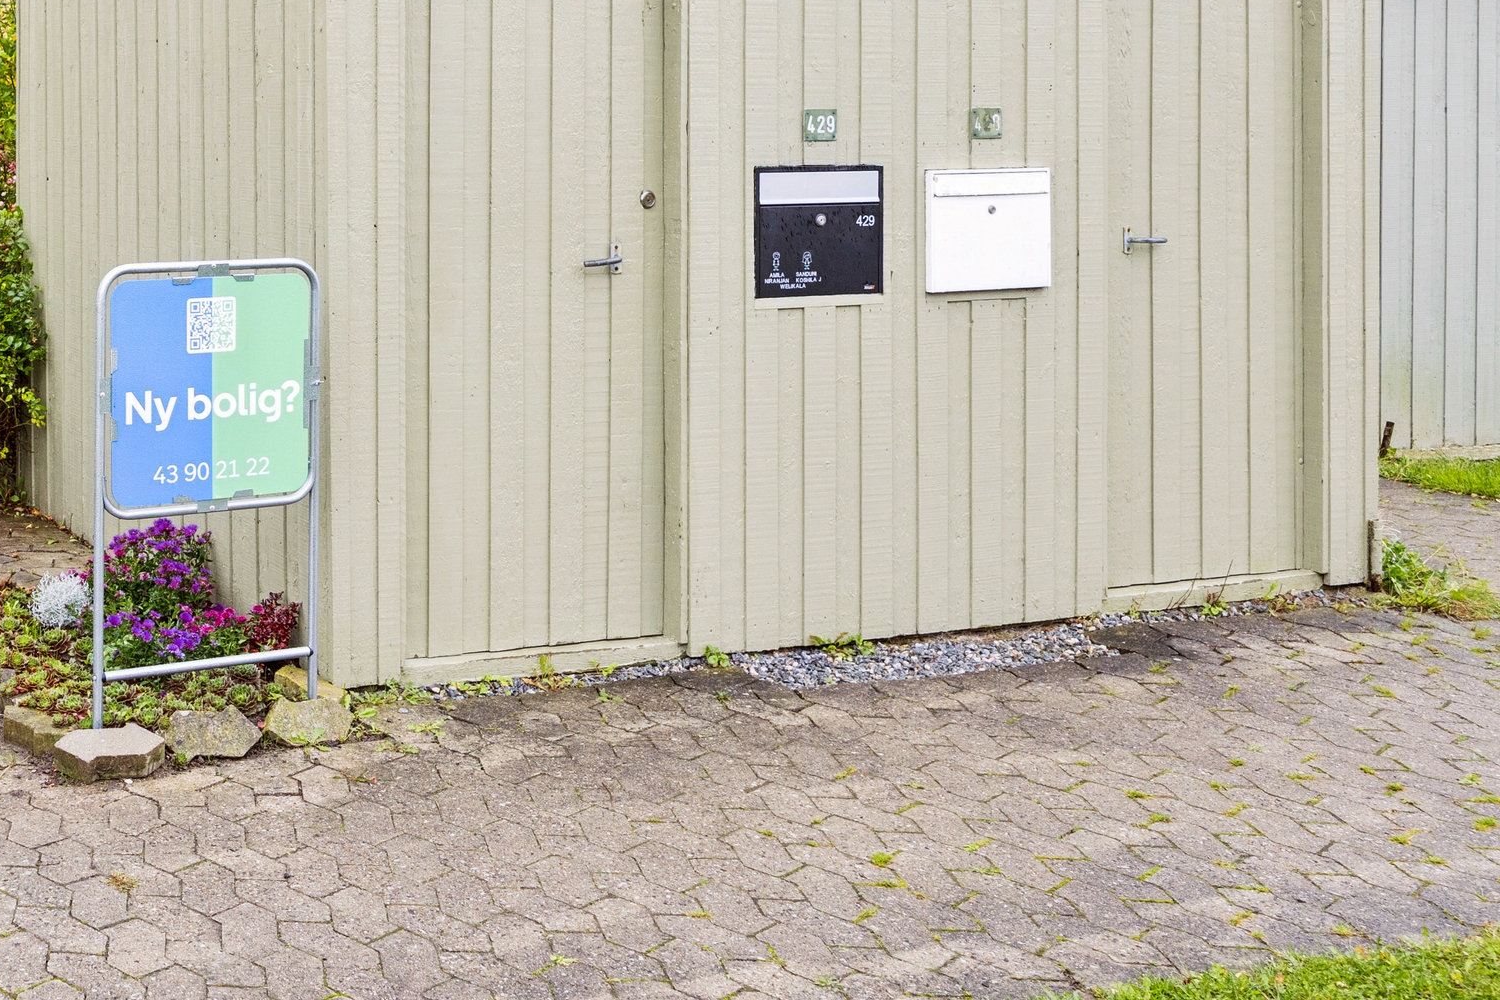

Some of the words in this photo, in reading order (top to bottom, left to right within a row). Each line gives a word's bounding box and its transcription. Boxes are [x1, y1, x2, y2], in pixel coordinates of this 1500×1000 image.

[807, 115, 835, 133] 429
[856, 215, 875, 226] 429
[124, 390, 177, 431] Ny
[187, 380, 300, 422] bolig?
[153, 465, 178, 484] 43
[184, 461, 210, 482] 90
[215, 459, 240, 479] 21
[246, 457, 270, 476] 22
